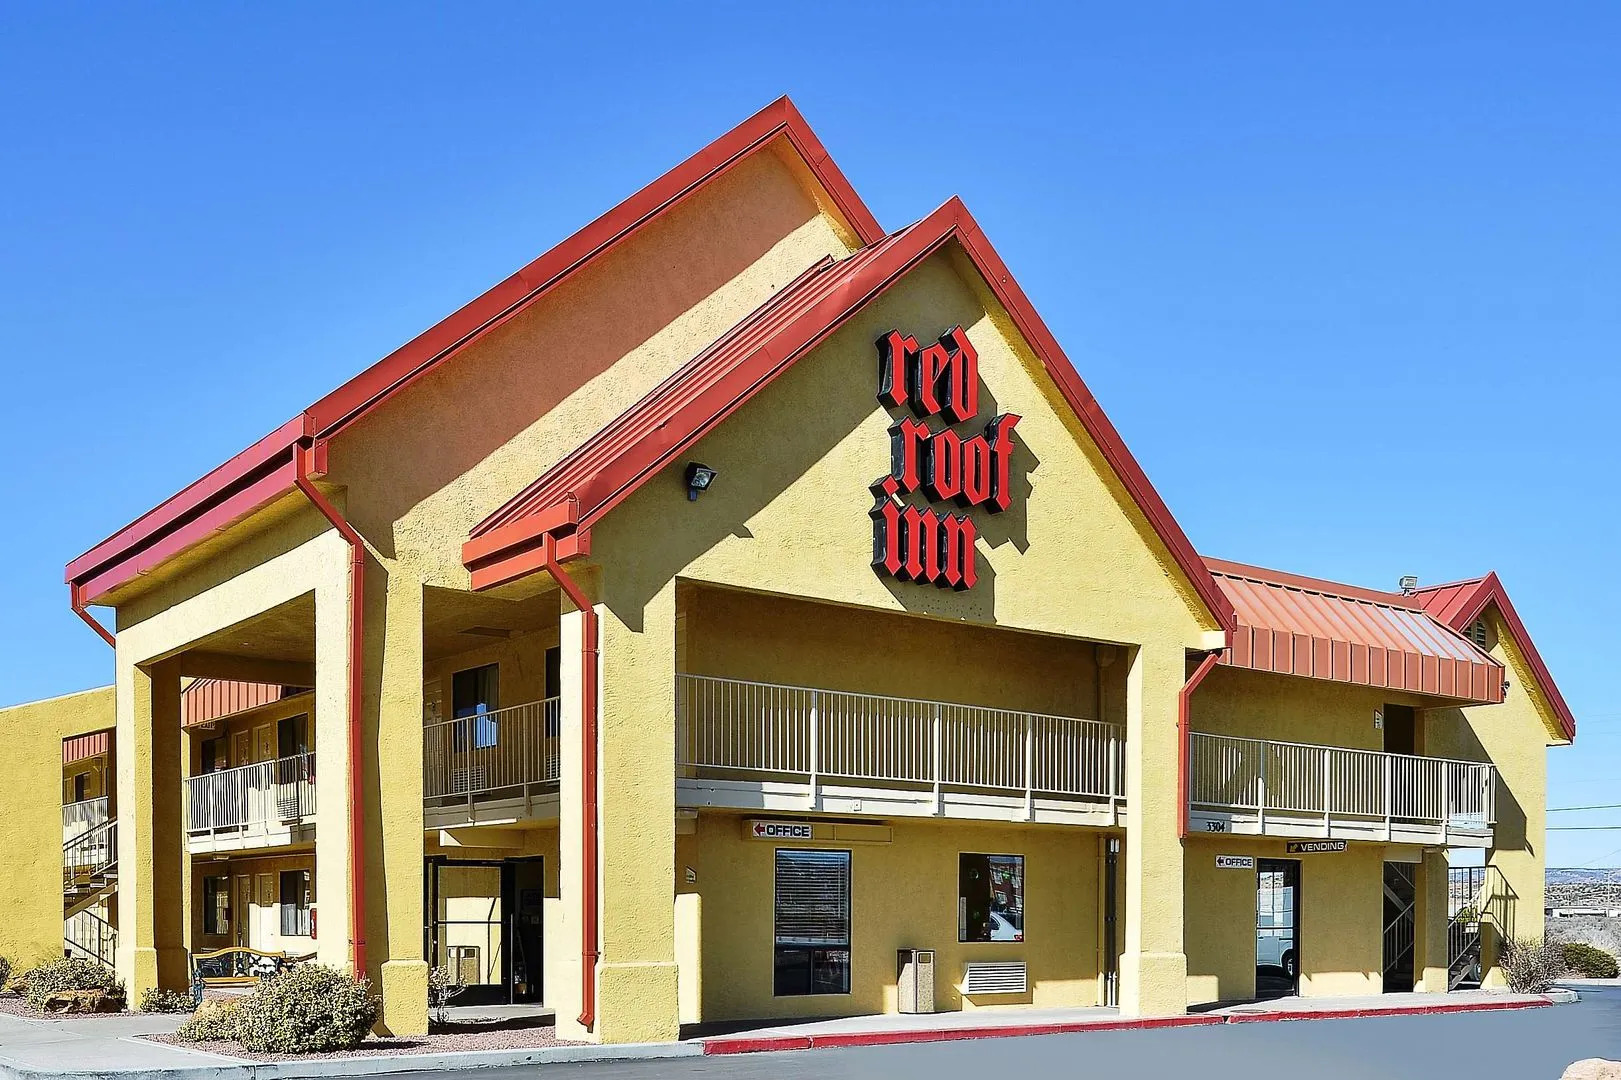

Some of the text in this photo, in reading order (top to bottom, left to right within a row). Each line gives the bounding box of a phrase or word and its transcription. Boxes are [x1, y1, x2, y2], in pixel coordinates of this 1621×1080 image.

[881, 325, 978, 422] red
[894, 412, 1023, 512] roof
[876, 474, 979, 590] inn
[766, 824, 810, 837] OFFICE
[1206, 821, 1225, 832] 3304
[1300, 842, 1345, 852] VENDING
[1225, 857, 1252, 867] OFFICE
